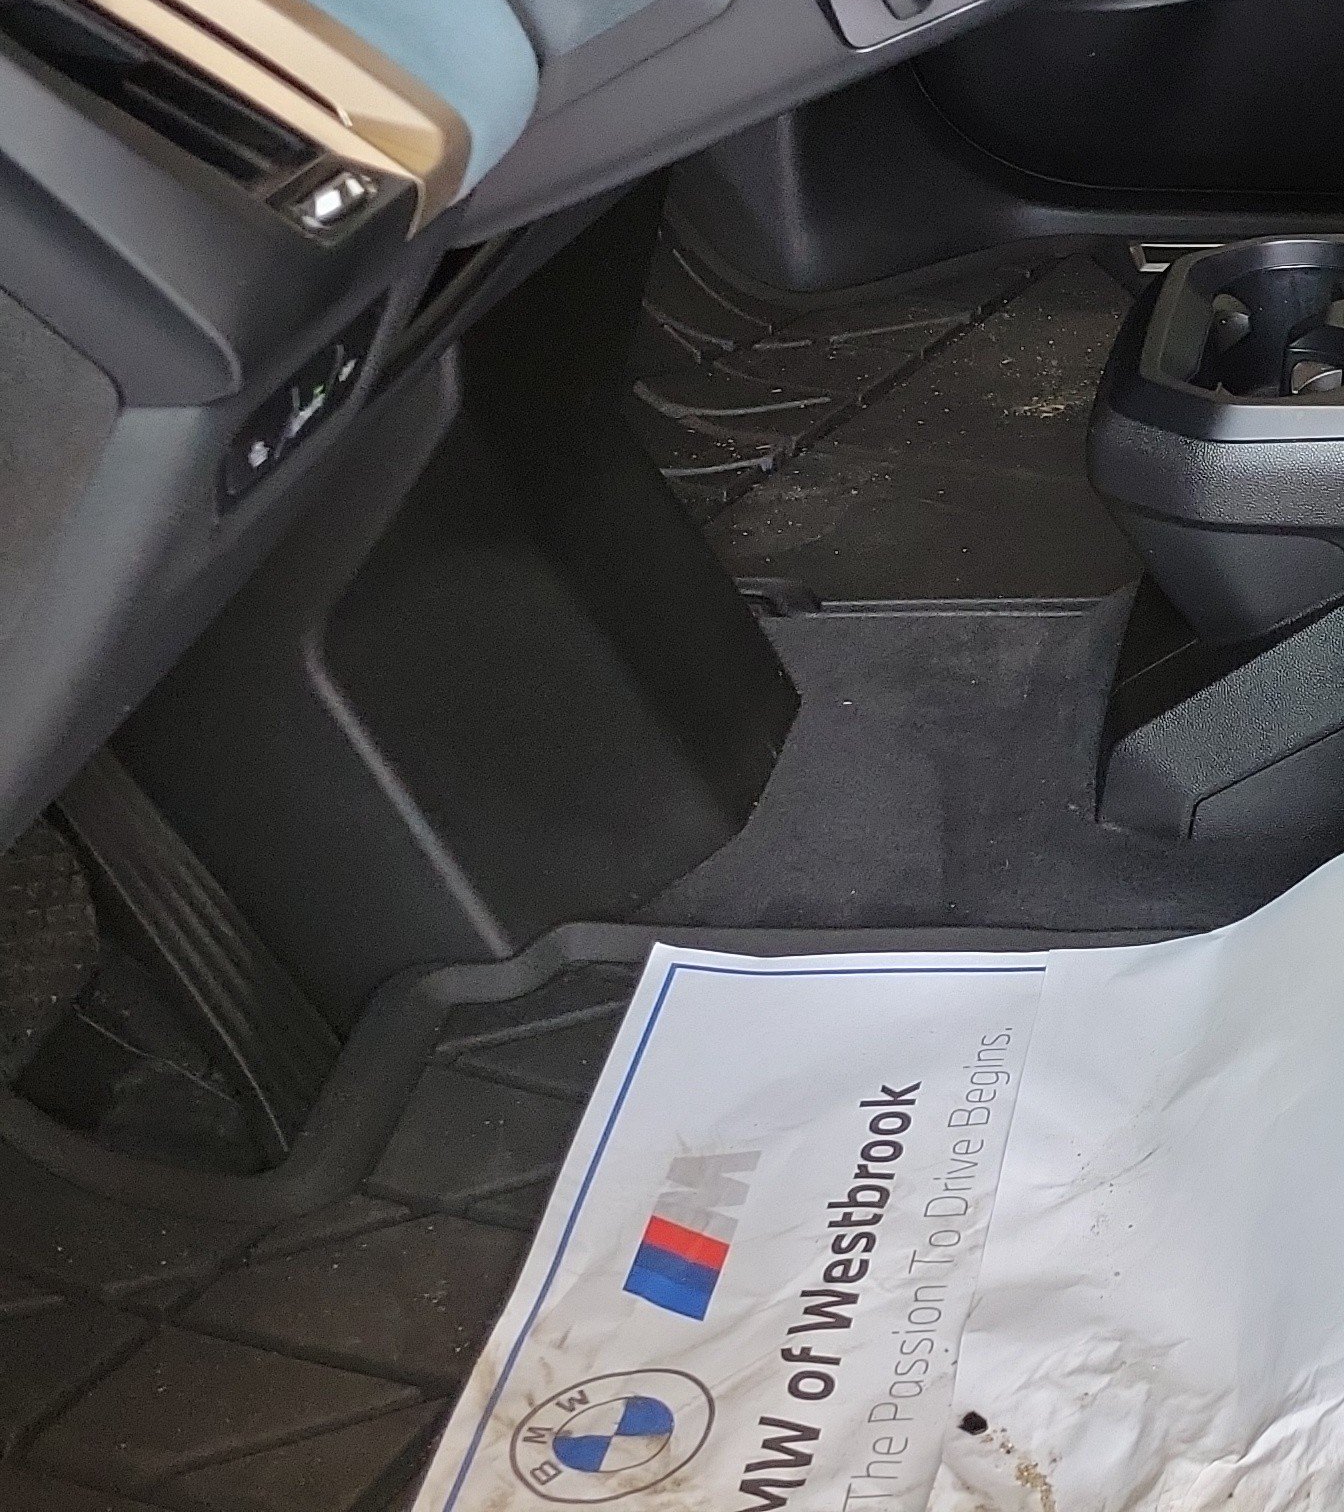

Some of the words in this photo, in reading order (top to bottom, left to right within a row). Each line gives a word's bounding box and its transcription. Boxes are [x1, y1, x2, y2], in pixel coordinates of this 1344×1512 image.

[947, 1027, 1013, 1128] Begins.
[786, 1080, 923, 1336] Westbrook
[923, 1139, 985, 1218] Drive
[908, 1229, 962, 1274] To
[780, 1345, 842, 1401] of
[867, 1285, 948, 1423] Passion
[523, 1389, 590, 1486] BMW
[736, 1416, 822, 1512] MW
[843, 1436, 909, 1512] The
